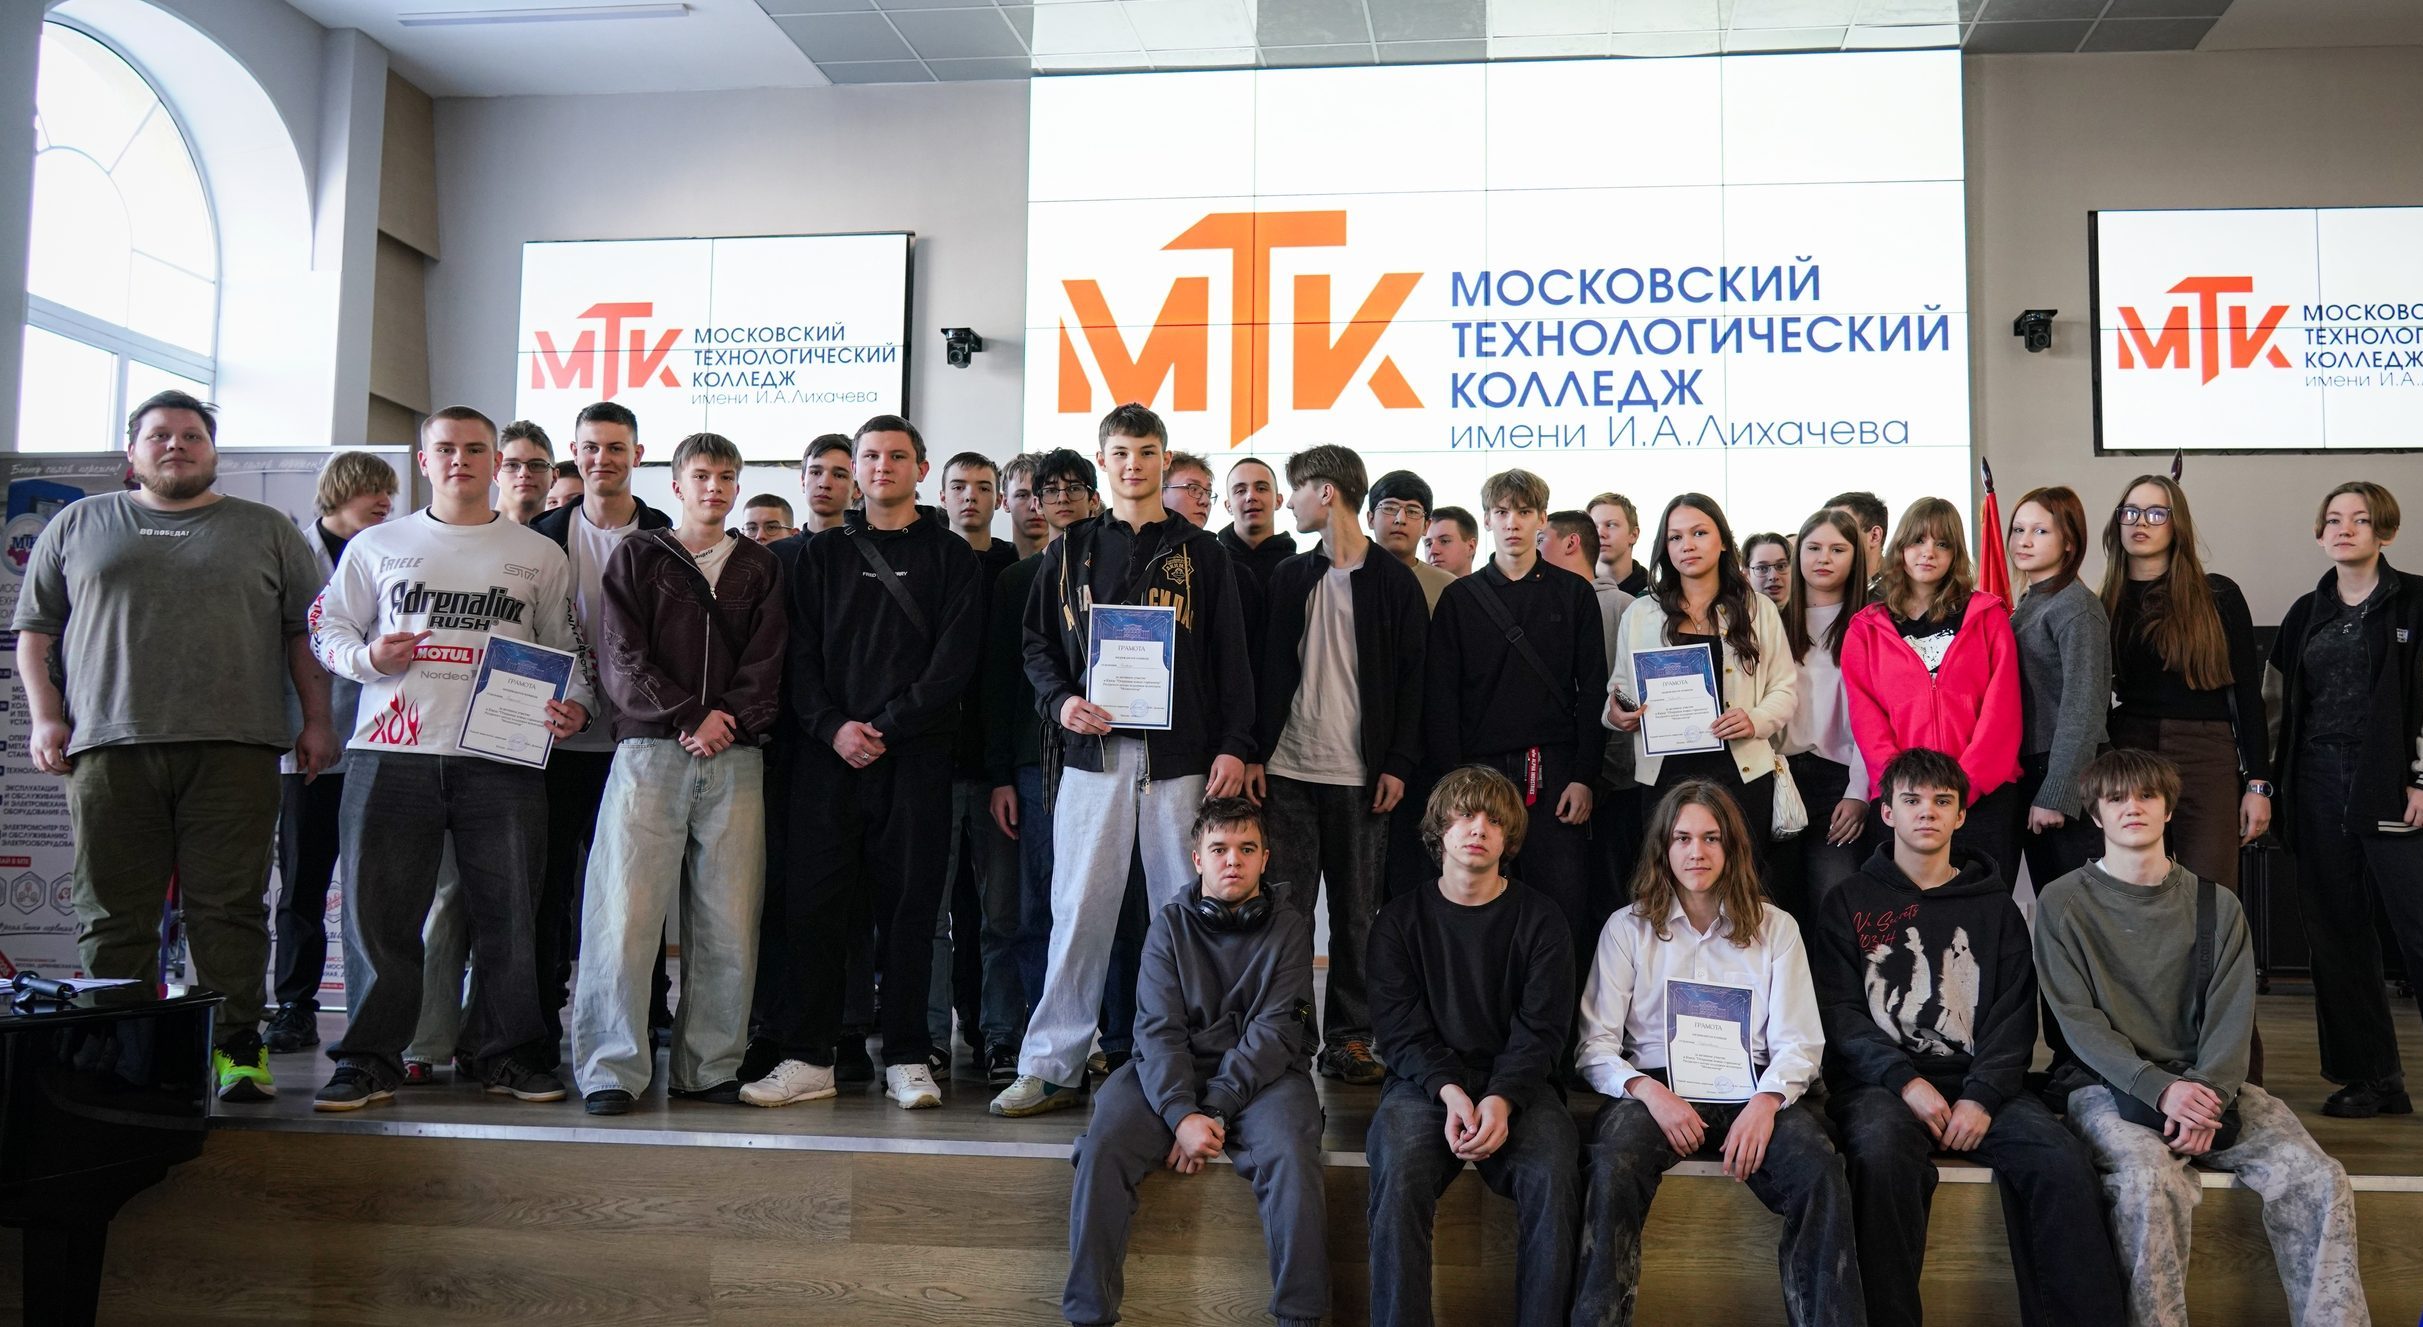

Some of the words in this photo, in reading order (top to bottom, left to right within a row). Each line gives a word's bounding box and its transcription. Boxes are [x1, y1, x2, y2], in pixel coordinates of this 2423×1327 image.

[1451, 255, 1820, 308] МОСКОВСКИЙ
[694, 321, 845, 344] МОСКОВСКИЙ
[1057, 210, 1425, 448] МТК
[1451, 304, 1949, 359] ТЕХНОЛОГИЧЕСКИЙ
[2117, 276, 2292, 385] МТК
[531, 302, 683, 401] МТК
[694, 342, 896, 366] ТЕХНОЛОГИЧЕСКИЙ
[2305, 351, 2423, 371] КОЛЛЕДЖ
[692, 370, 796, 389] КОЛЛЕДЖ
[2305, 375, 2370, 387] имени
[2380, 371, 2423, 387] И.А.
[692, 393, 748, 405] имени
[756, 389, 878, 404] И.А.Лихачева
[1451, 369, 1703, 414] КОЛЛЕДЖ
[1451, 423, 1586, 449] имени
[1608, 414, 1909, 449] И.А.Лихачева
[427, 614, 491, 632] RUSH
[415, 647, 471, 662] MOTUL
[420, 670, 469, 681] Nordea
